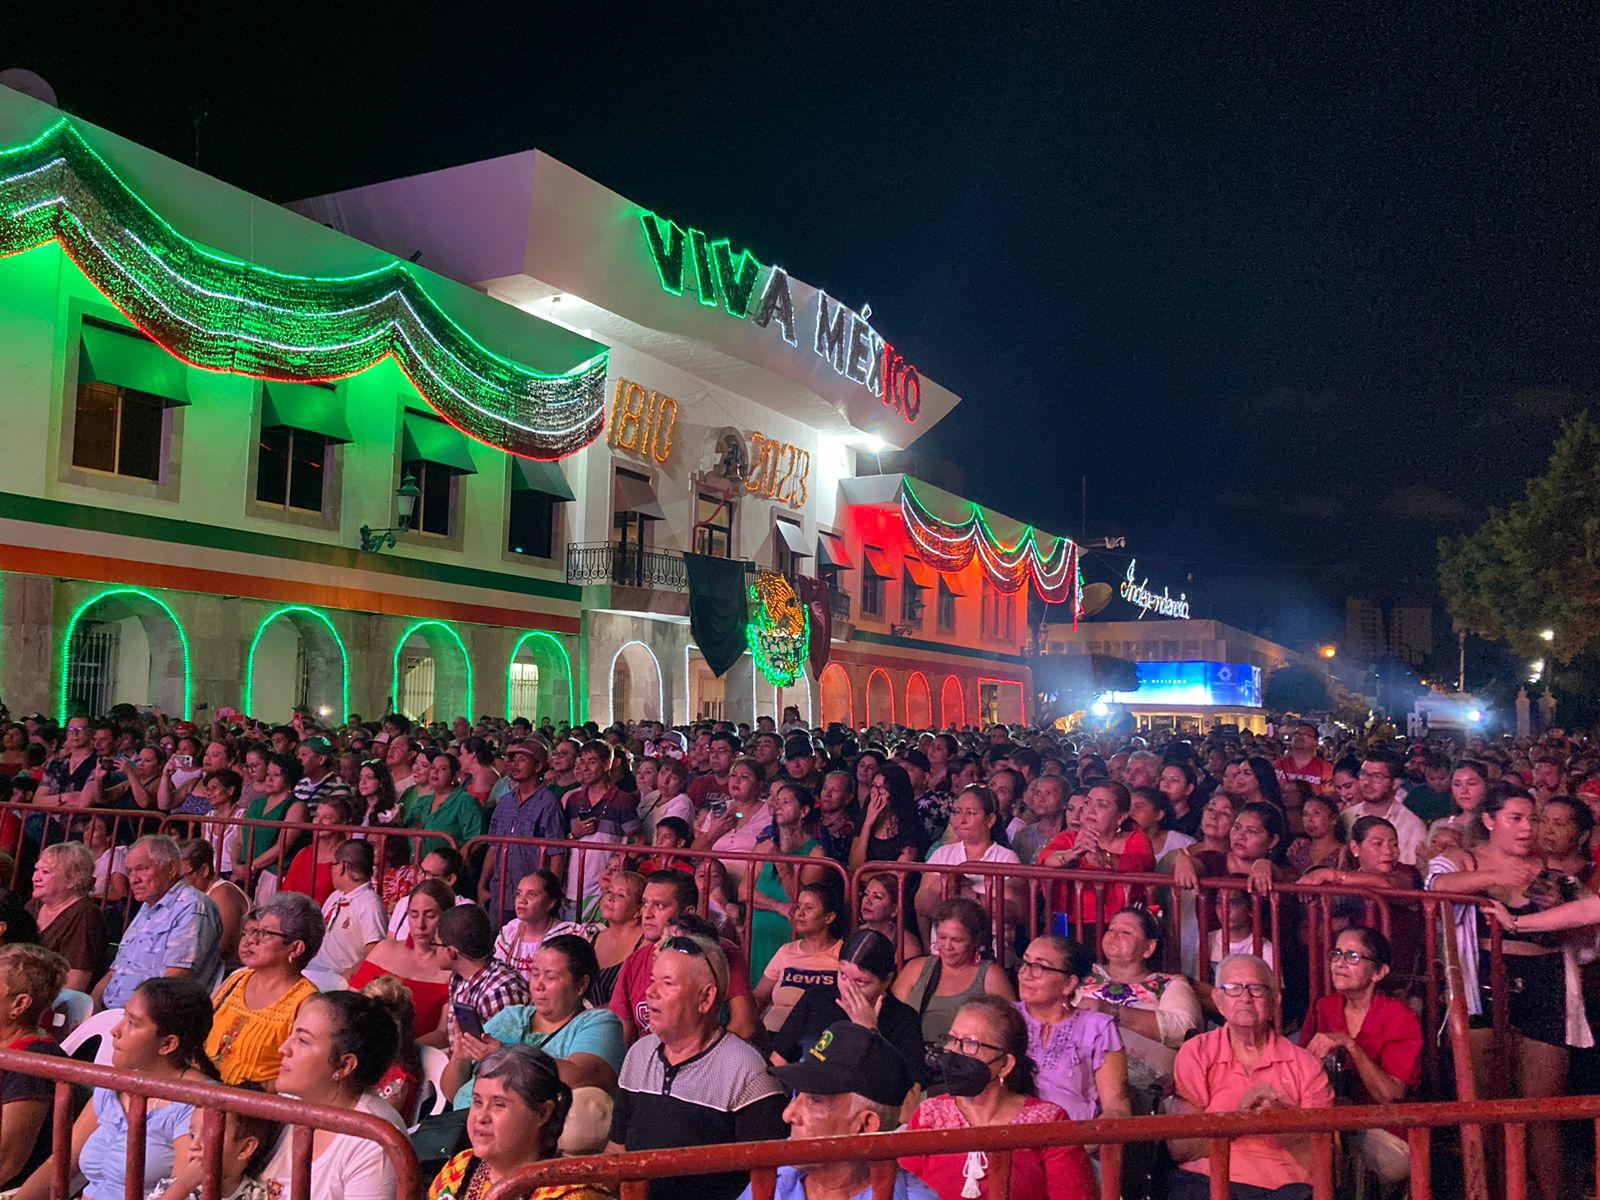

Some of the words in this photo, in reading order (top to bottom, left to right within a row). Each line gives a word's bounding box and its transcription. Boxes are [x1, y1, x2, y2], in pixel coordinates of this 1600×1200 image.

[640, 211, 797, 347] VIVA
[814, 290, 921, 424] MÉXICO
[606, 377, 678, 463] 1810
[745, 431, 810, 509] 2023
